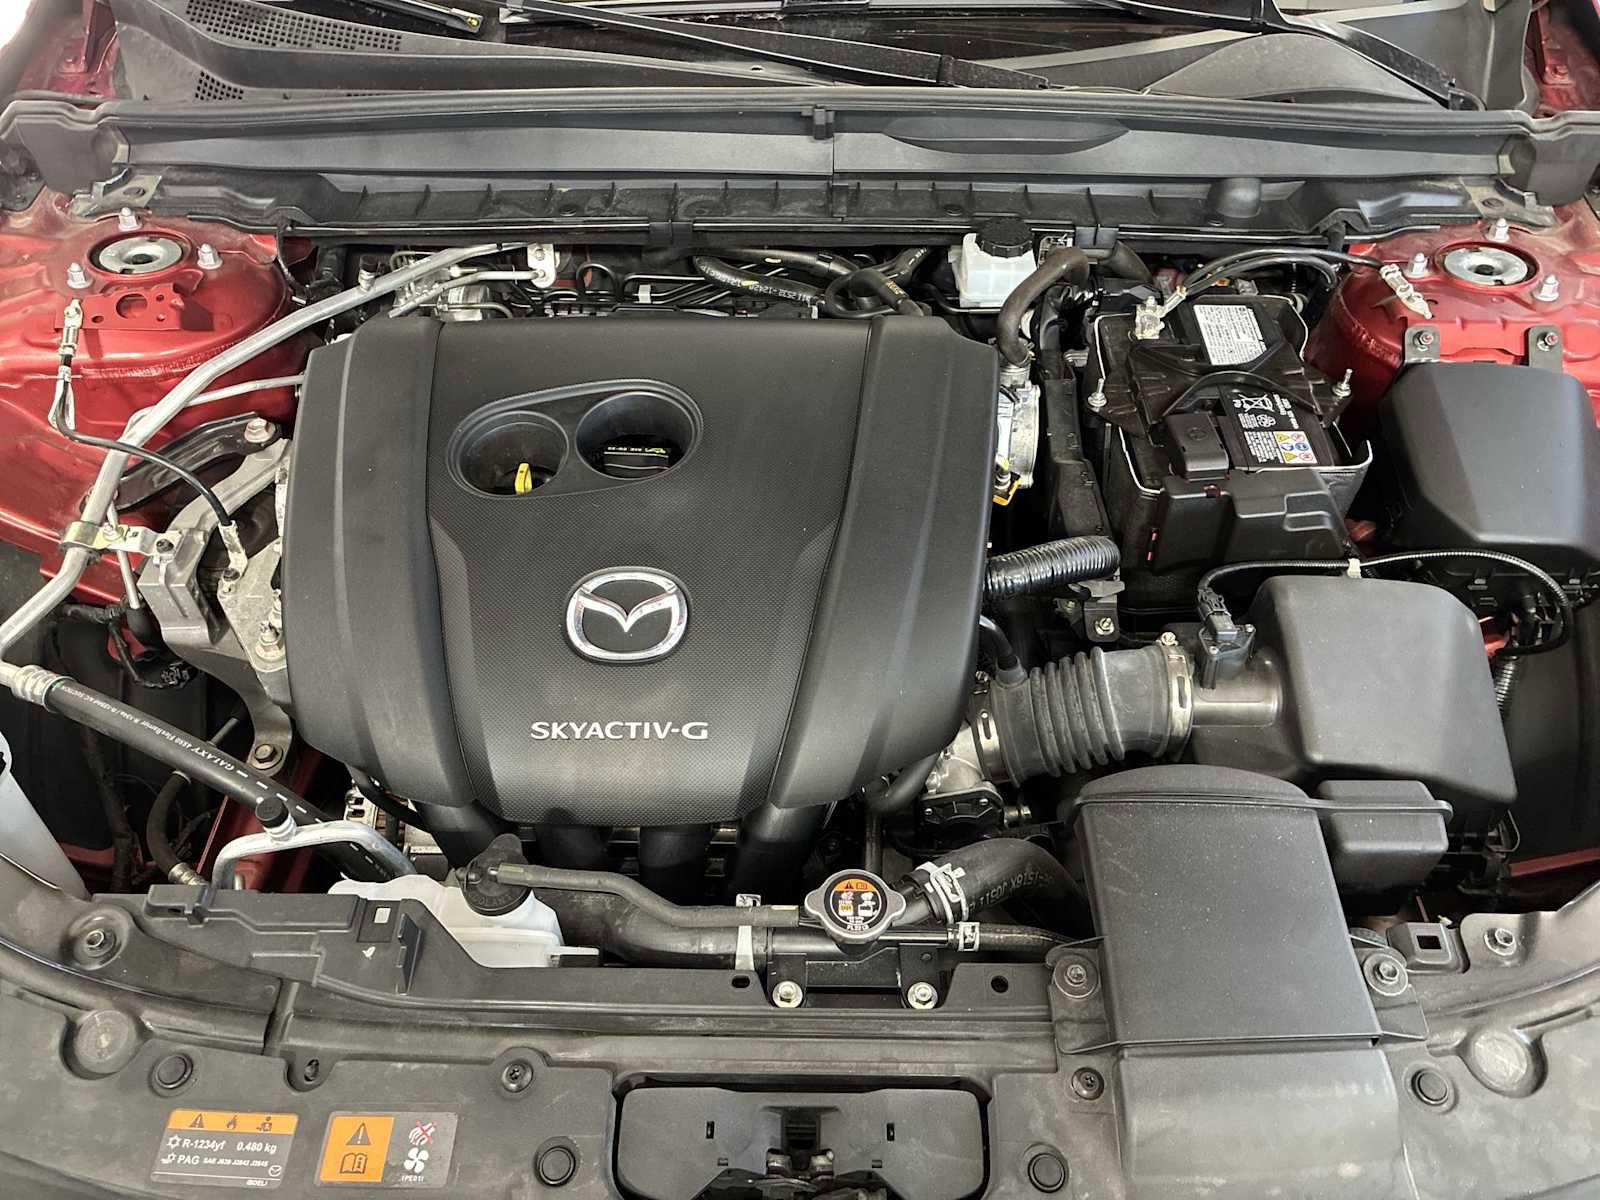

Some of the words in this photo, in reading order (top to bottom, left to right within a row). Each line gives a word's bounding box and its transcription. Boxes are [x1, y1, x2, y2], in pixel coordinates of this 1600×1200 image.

[530, 721, 709, 741] SKYACTIV-G
[191, 747, 236, 771] GALAXY
[182, 1138, 227, 1152] R-1234yf
[236, 1141, 263, 1152] 0.480
[264, 1143, 277, 1155] kg
[177, 1154, 200, 1165] PAG
